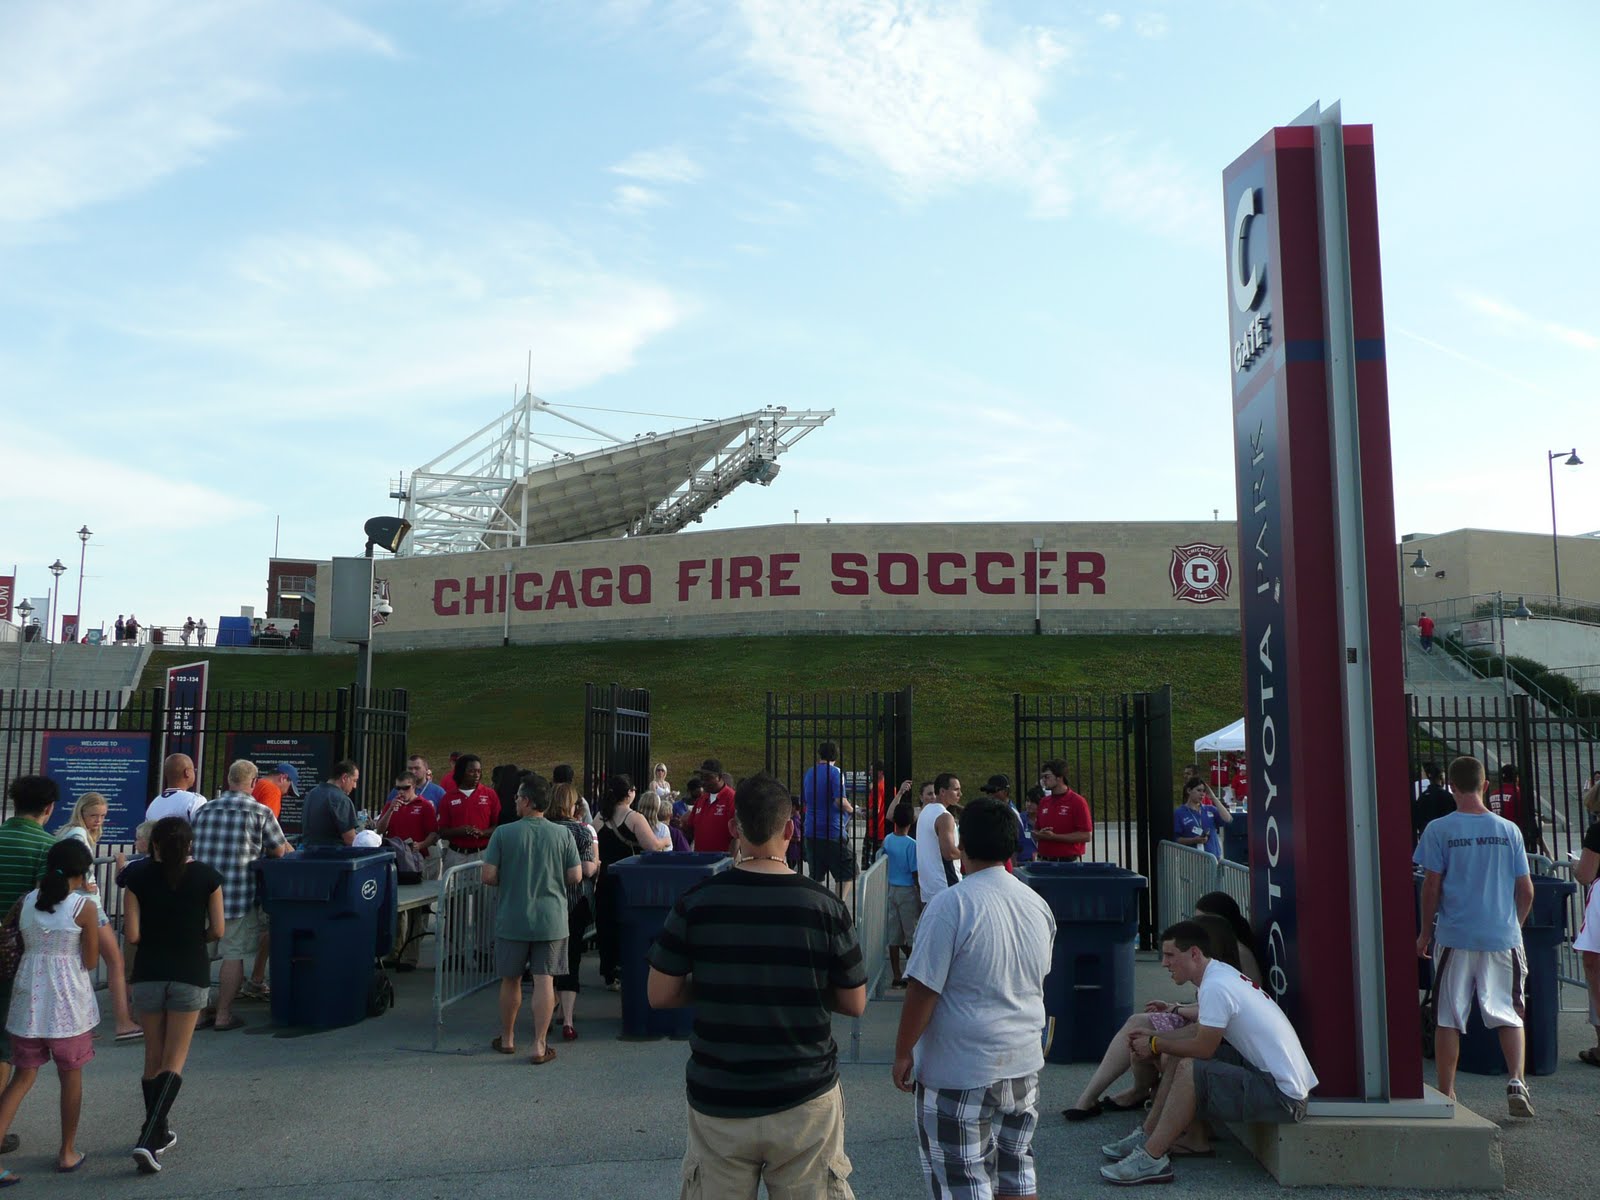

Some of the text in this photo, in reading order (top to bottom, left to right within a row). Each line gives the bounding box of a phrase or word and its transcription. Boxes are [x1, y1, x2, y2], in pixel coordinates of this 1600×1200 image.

[1232, 187, 1257, 313] C
[1234, 311, 1263, 373] GATE
[1250, 418, 1270, 594] PARK
[431, 551, 1106, 616] CHICAGO FIRE SOCCER
[1191, 563, 1209, 583] C
[1258, 623, 1282, 910] TOYOTA
[1475, 836, 1510, 847] WORK
